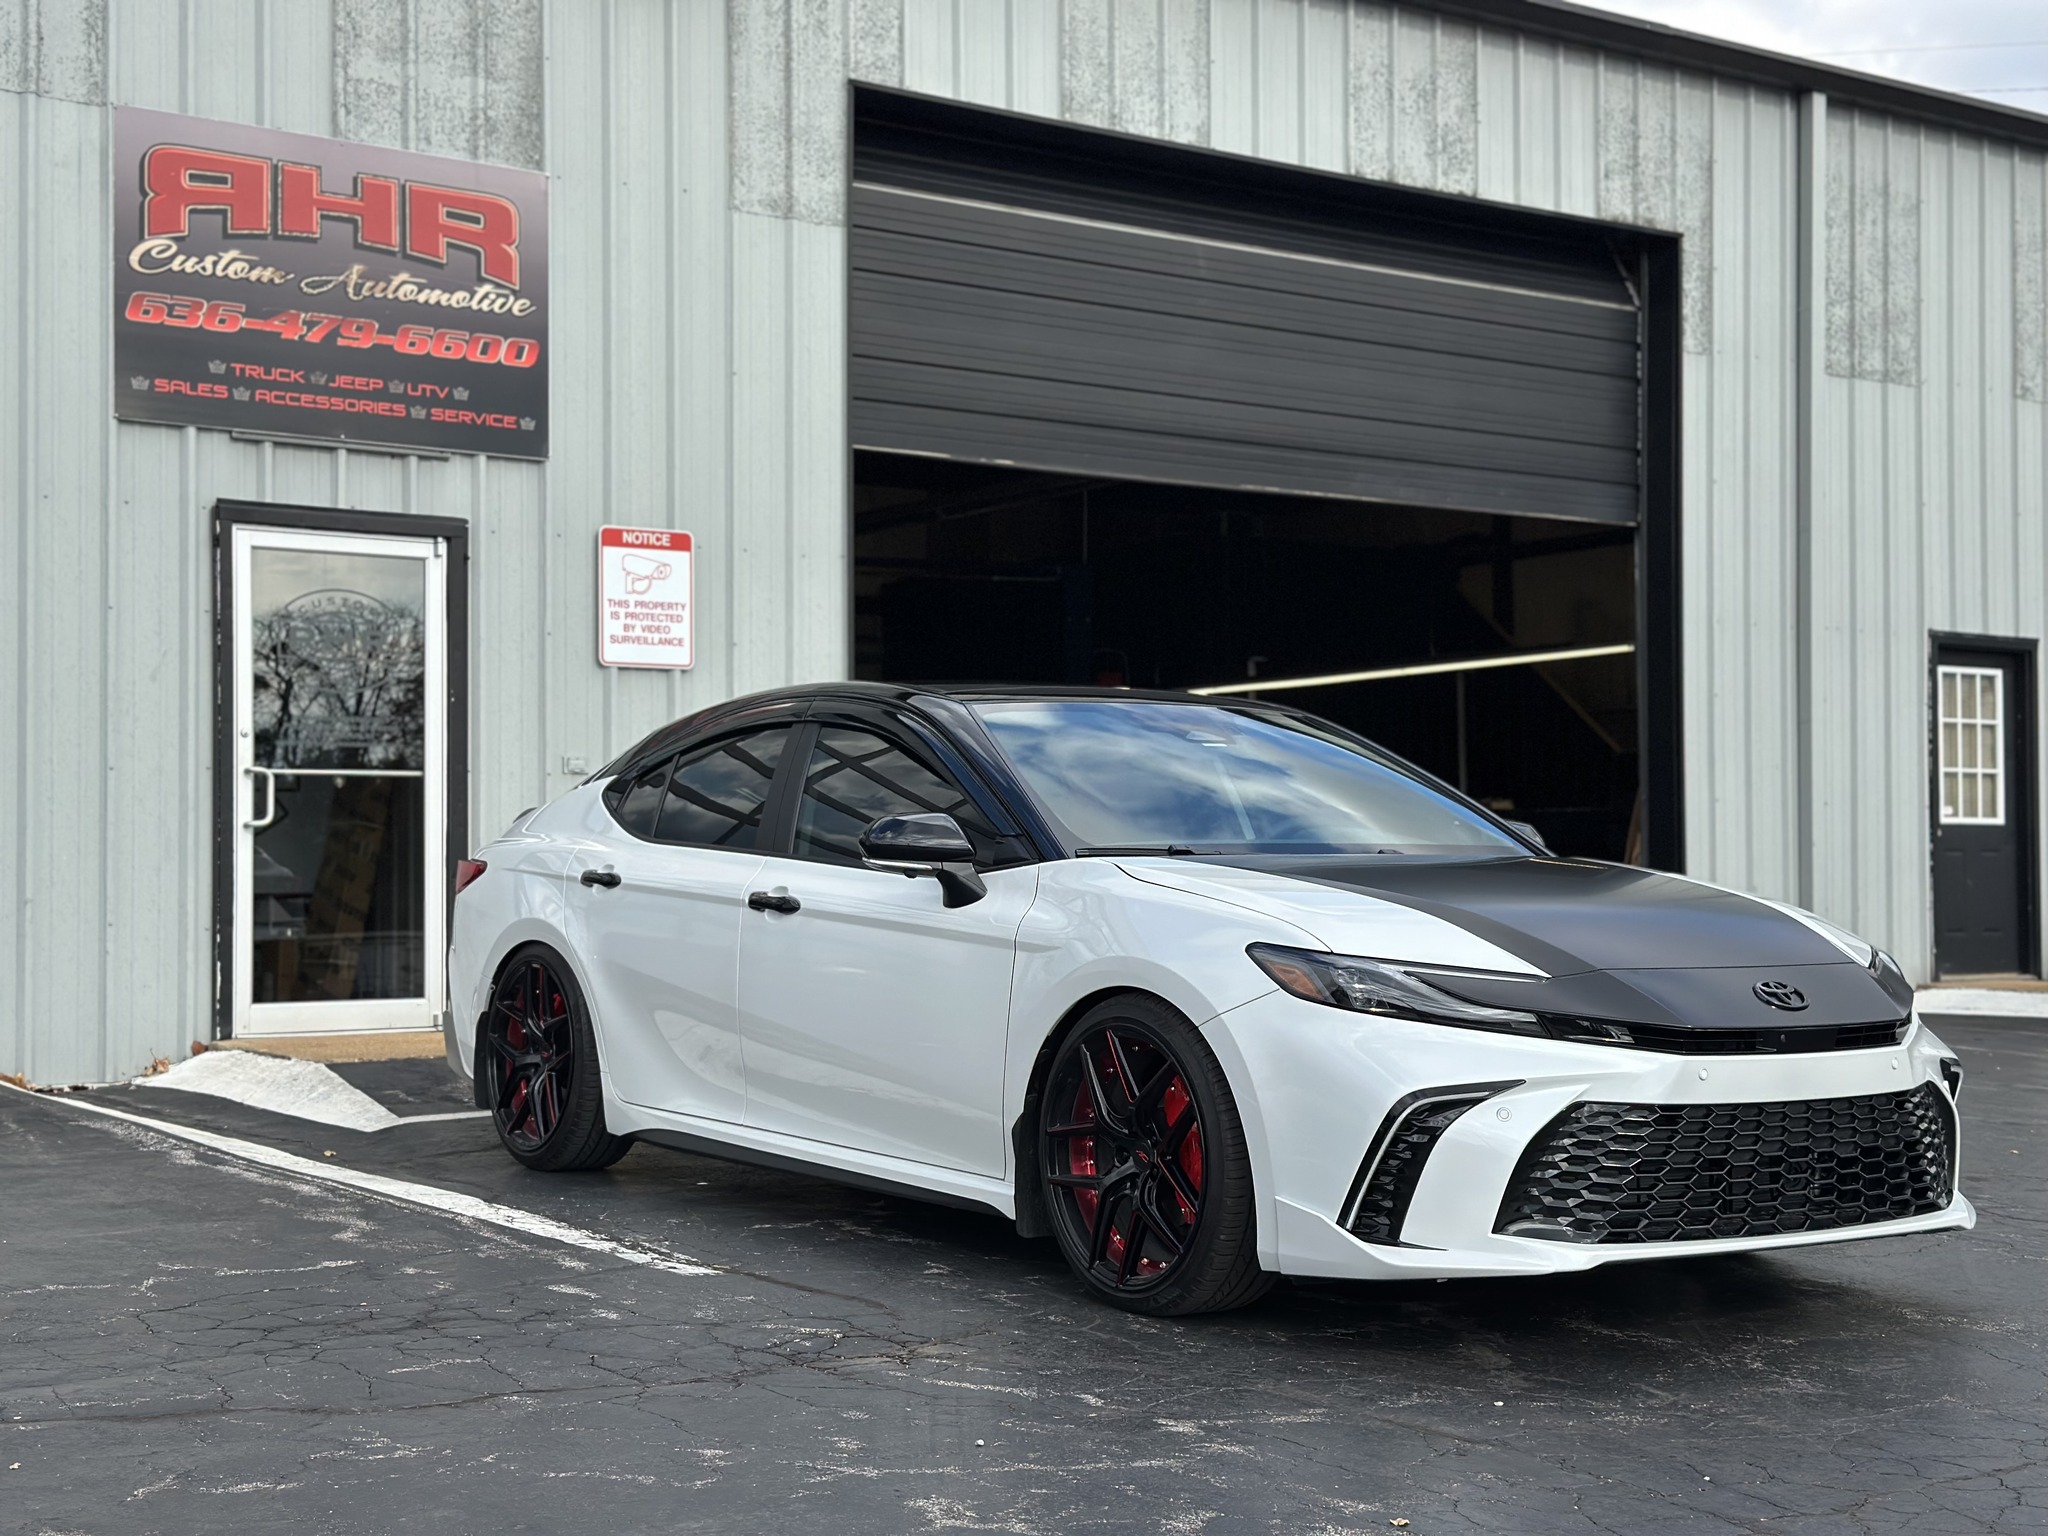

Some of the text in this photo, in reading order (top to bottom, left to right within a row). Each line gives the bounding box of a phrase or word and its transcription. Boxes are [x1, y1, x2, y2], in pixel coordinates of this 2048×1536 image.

[128, 239, 537, 316] Custom Automotive
[125, 292, 540, 368] 636-479-6600
[230, 363, 449, 399] TRUCK JEEP UTV
[154, 378, 517, 429] SALES ACCESSORIES SERVICE
[622, 531, 671, 546] NOTICE
[607, 599, 687, 611] THIS PROPERTY
[610, 611, 683, 623] IS PROTECTED
[623, 623, 671, 634] BY VIDEO
[609, 634, 685, 647] SURVEILLANCE
